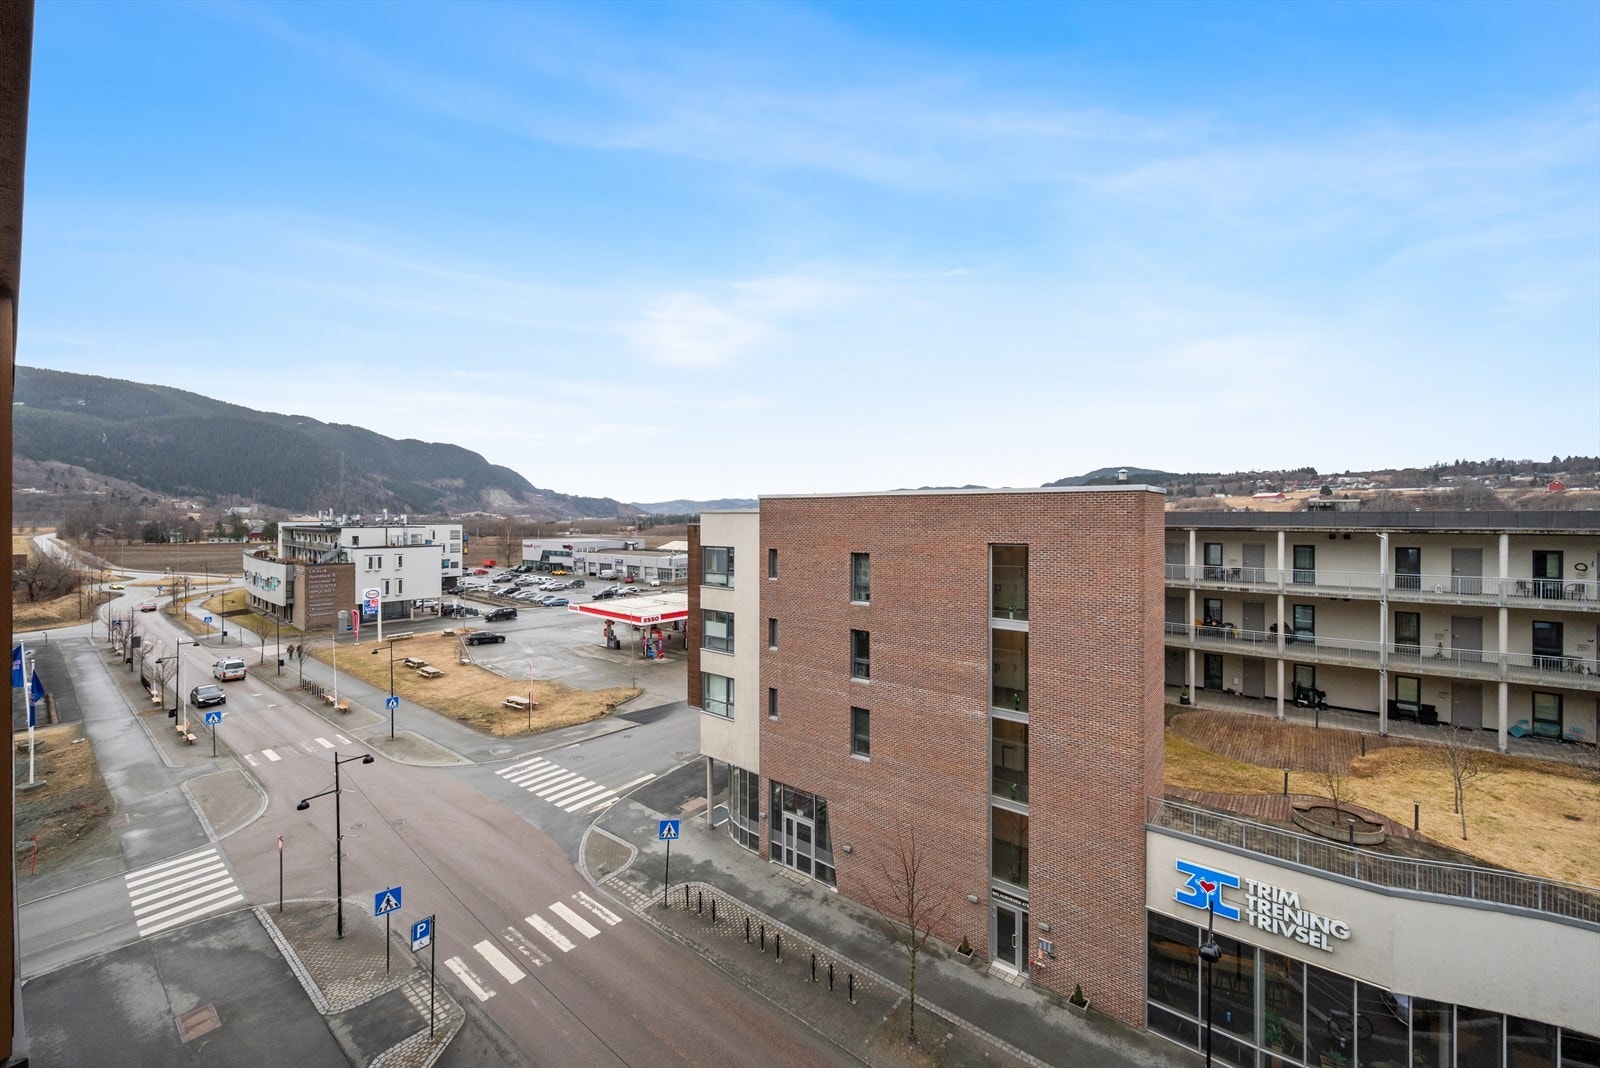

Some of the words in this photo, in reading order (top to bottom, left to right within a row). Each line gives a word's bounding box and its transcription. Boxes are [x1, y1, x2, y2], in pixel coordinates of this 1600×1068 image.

[1245, 877, 1300, 909] TRIM
[417, 923, 426, 938] P
[1245, 893, 1351, 940] TRENING
[1245, 908, 1334, 953] TRIVSEL
